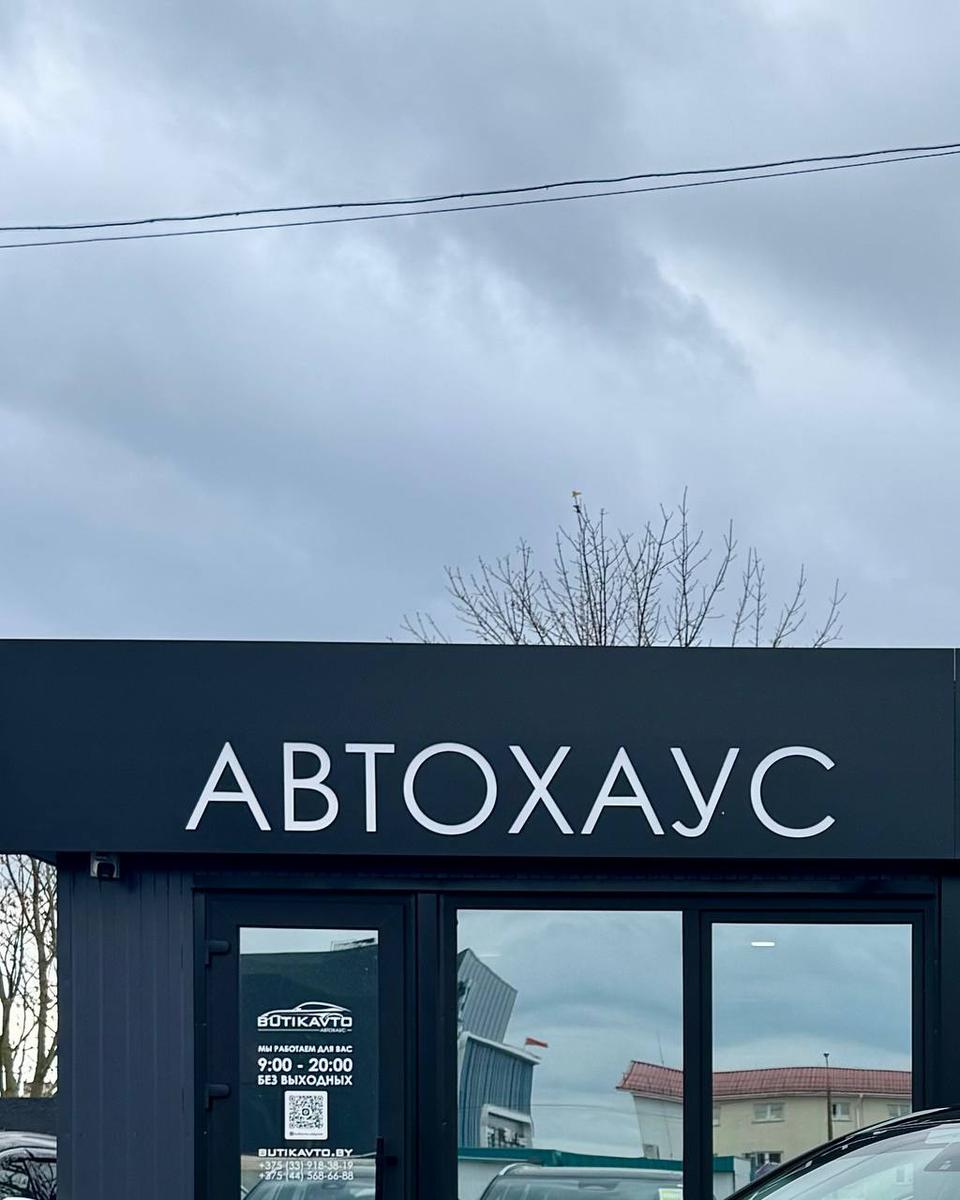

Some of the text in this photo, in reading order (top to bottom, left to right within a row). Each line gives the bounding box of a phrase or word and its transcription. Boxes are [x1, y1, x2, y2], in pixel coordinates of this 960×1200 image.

[185, 741, 836, 839] АВТОХАУС
[257, 1016, 353, 1027] BUTIKAVTO
[257, 1045, 353, 1053] МЫ РАБОТАЕМ ДЛЯ ВАС
[257, 1057, 293, 1072] 9:00
[308, 1057, 353, 1072] 20:00
[257, 1074, 353, 1087] БЕЗ ВЫХОДНЫХ
[258, 1148, 353, 1157] BUTIKAVTO.BY
[259, 1161, 283, 1170] +375
[285, 1161, 304, 1171] (33)
[285, 1171, 304, 1182] (44)
[306, 1171, 354, 1181] 568-66-88
